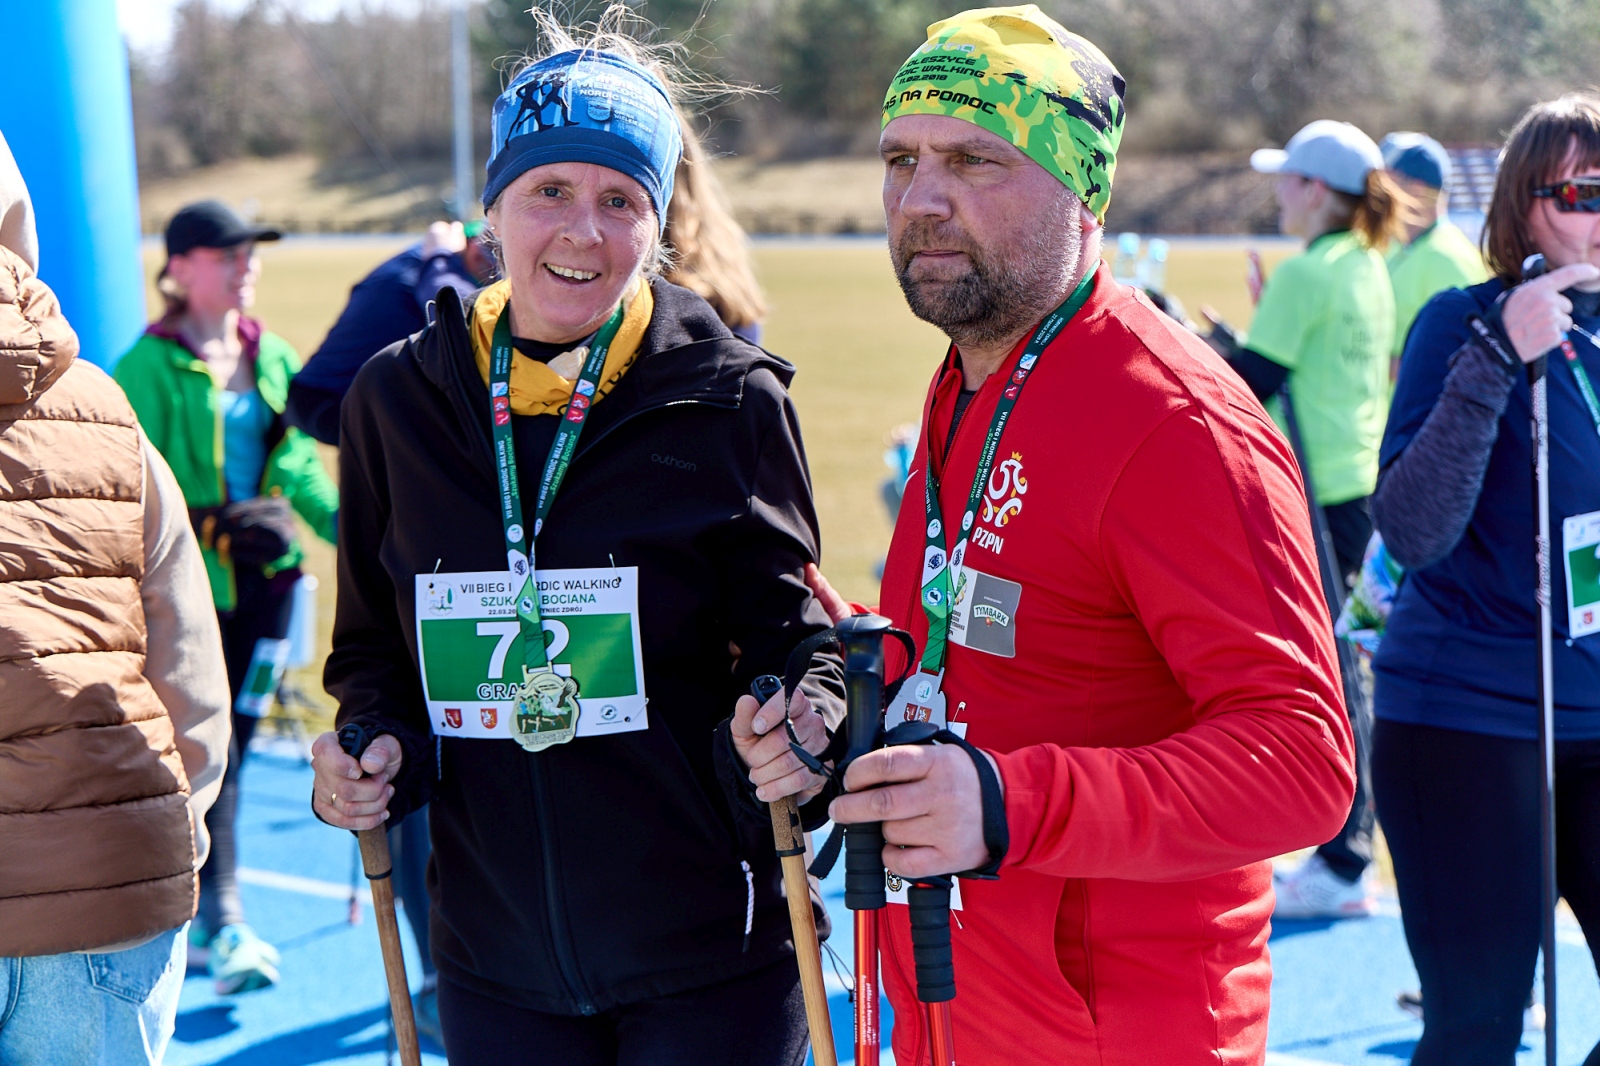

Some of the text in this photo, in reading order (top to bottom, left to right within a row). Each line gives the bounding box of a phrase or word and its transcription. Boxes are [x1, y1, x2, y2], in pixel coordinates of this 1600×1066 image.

[921, 65, 985, 78] WALKING
[580, 89, 659, 119] NORDIC WALKING
[900, 90, 922, 103] NA
[926, 90, 997, 115] POMOC
[1000, 411, 1009, 421] VII
[994, 421, 1004, 437] BIEG
[497, 440, 507, 468] WALKING
[552, 432, 568, 459] WALKING
[985, 440, 997, 467] NORDIC
[544, 458, 558, 482] NORDIC
[651, 453, 697, 472] outhorn
[500, 467, 510, 492] NORDIC
[975, 468, 989, 499] WALKING
[504, 494, 512, 510] BIEG
[540, 485, 549, 500] BIEG
[505, 509, 513, 519] VII
[972, 527, 1004, 555] PZPN
[460, 584, 475, 594] VII
[476, 583, 505, 593] BIEG
[536, 581, 560, 591] RDIC
[563, 579, 621, 590] WALKING
[541, 594, 596, 605] BOCIANA
[975, 606, 1008, 625] TYMBARK
[476, 619, 571, 680] 72
